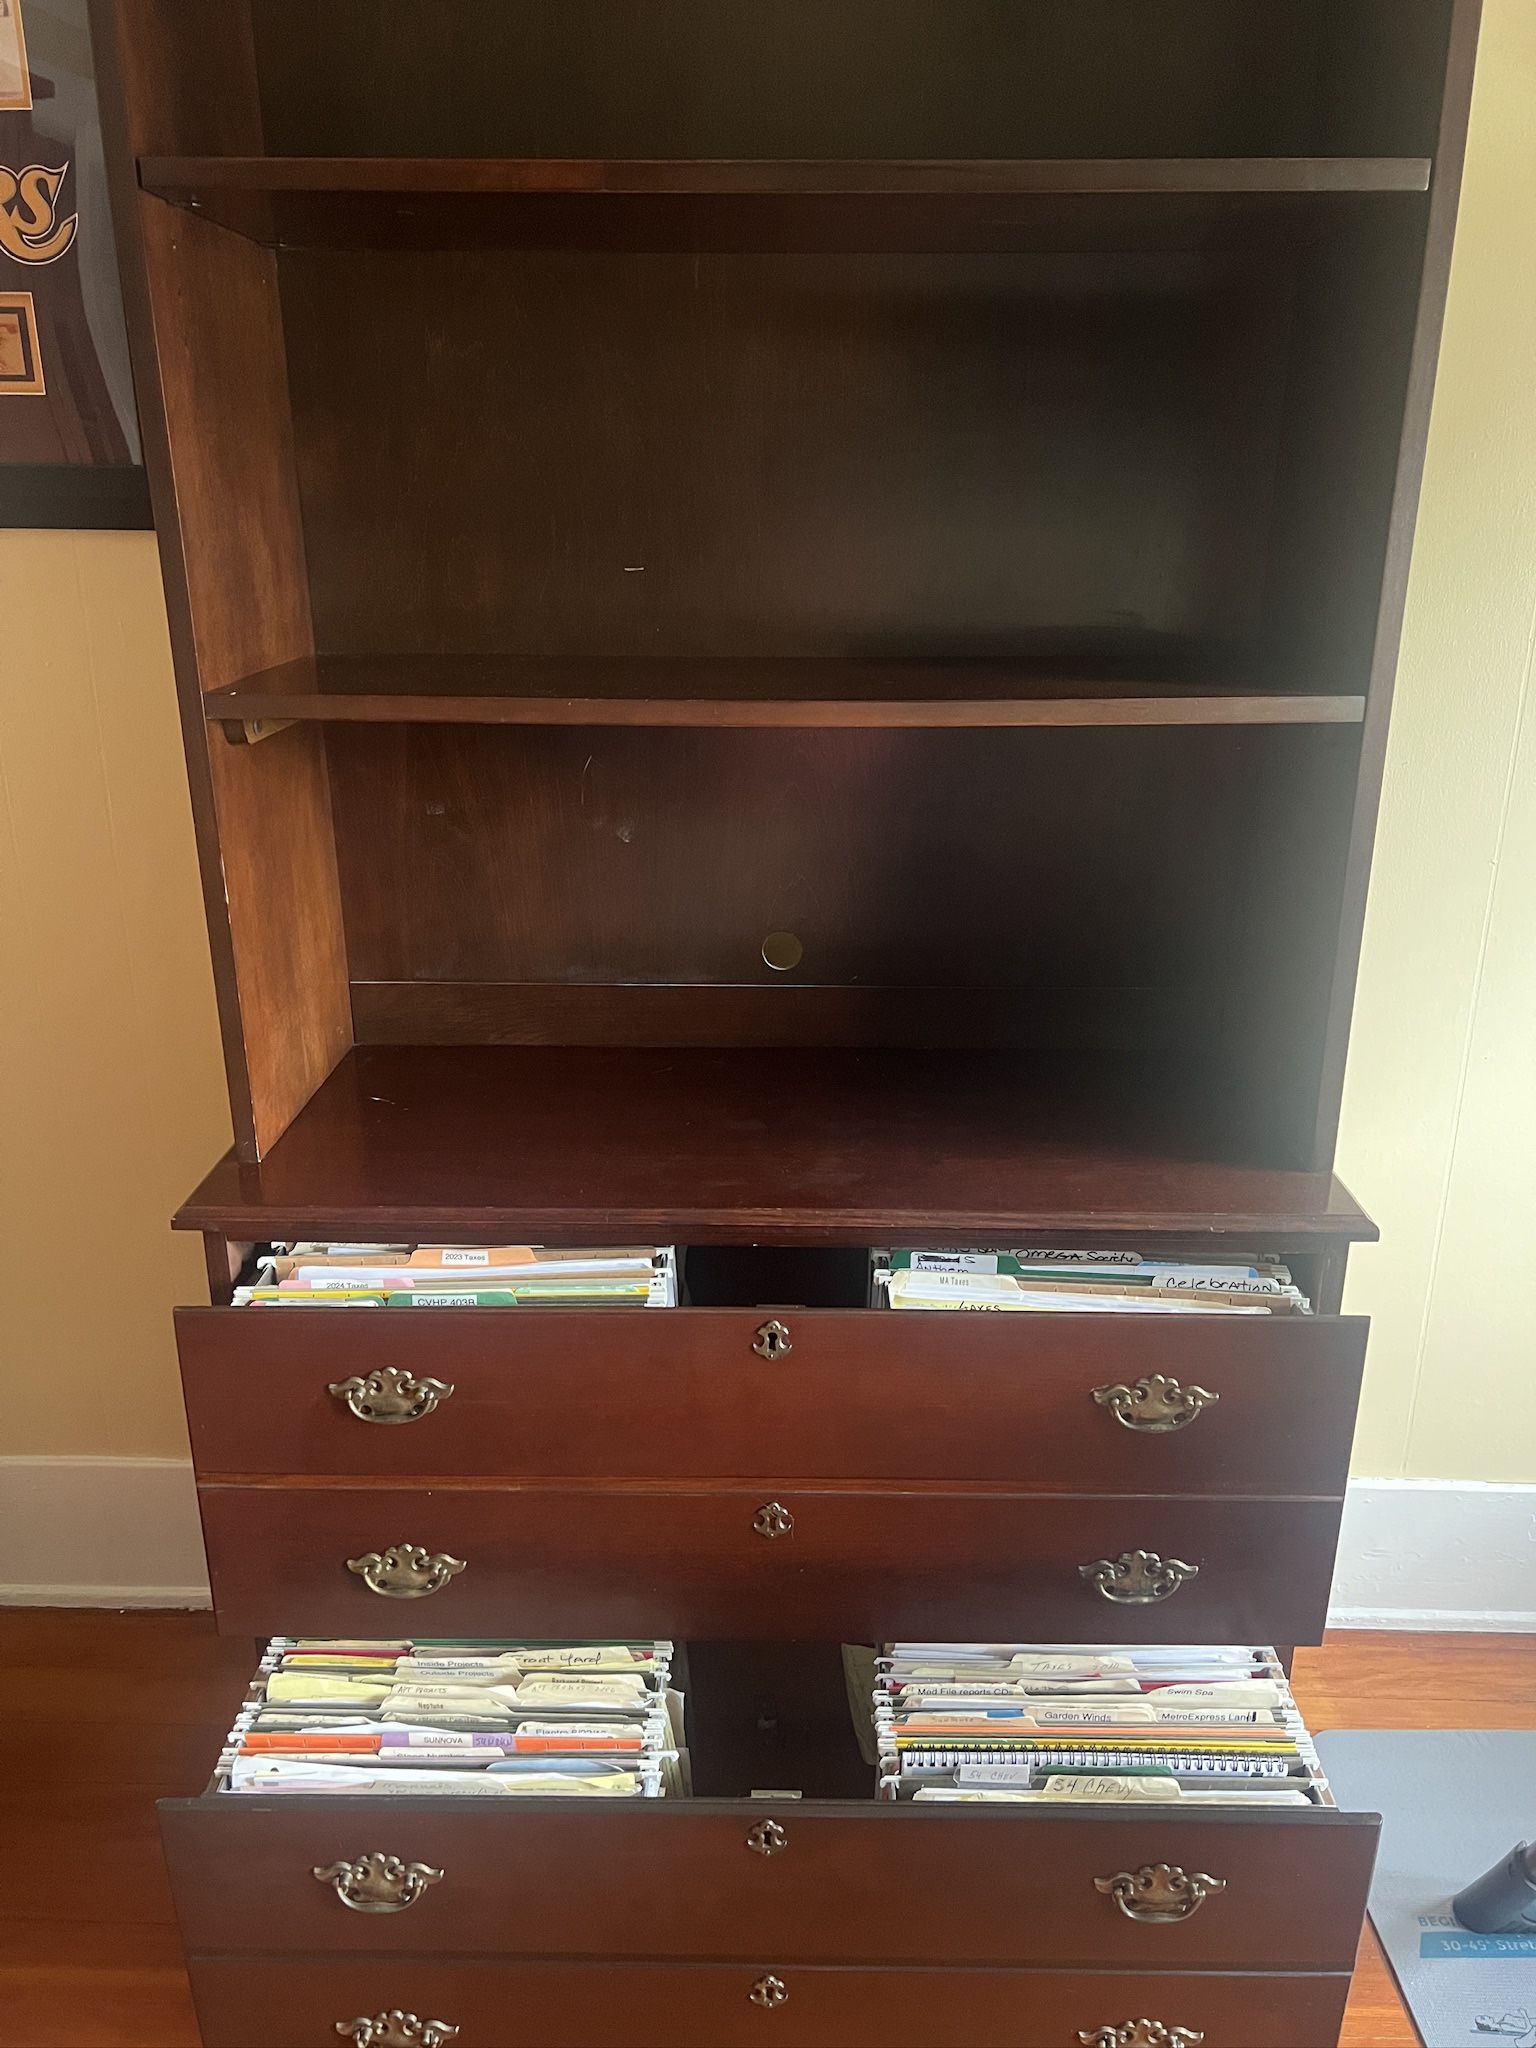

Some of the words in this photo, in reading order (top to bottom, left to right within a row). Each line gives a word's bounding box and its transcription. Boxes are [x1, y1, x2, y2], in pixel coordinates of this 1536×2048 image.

[445, 1253, 463, 1261] 2023
[951, 1277, 970, 1286] Taxes
[417, 1298, 448, 1306] CVHP
[917, 1687, 938, 1695] Med
[940, 1687, 957, 1695] File
[959, 1687, 991, 1695] reports
[1194, 1689, 1214, 1697] Spa
[417, 1702, 444, 1710] Neptune
[1044, 1711, 1080, 1720] Garden
[1082, 1712, 1112, 1722] Winds
[1161, 1712, 1226, 1721] MetroExpress
[423, 1736, 464, 1744] SUNNOVA
[1053, 1776, 1077, 1794] 54
[1418, 1916, 1460, 1927] BEGI
